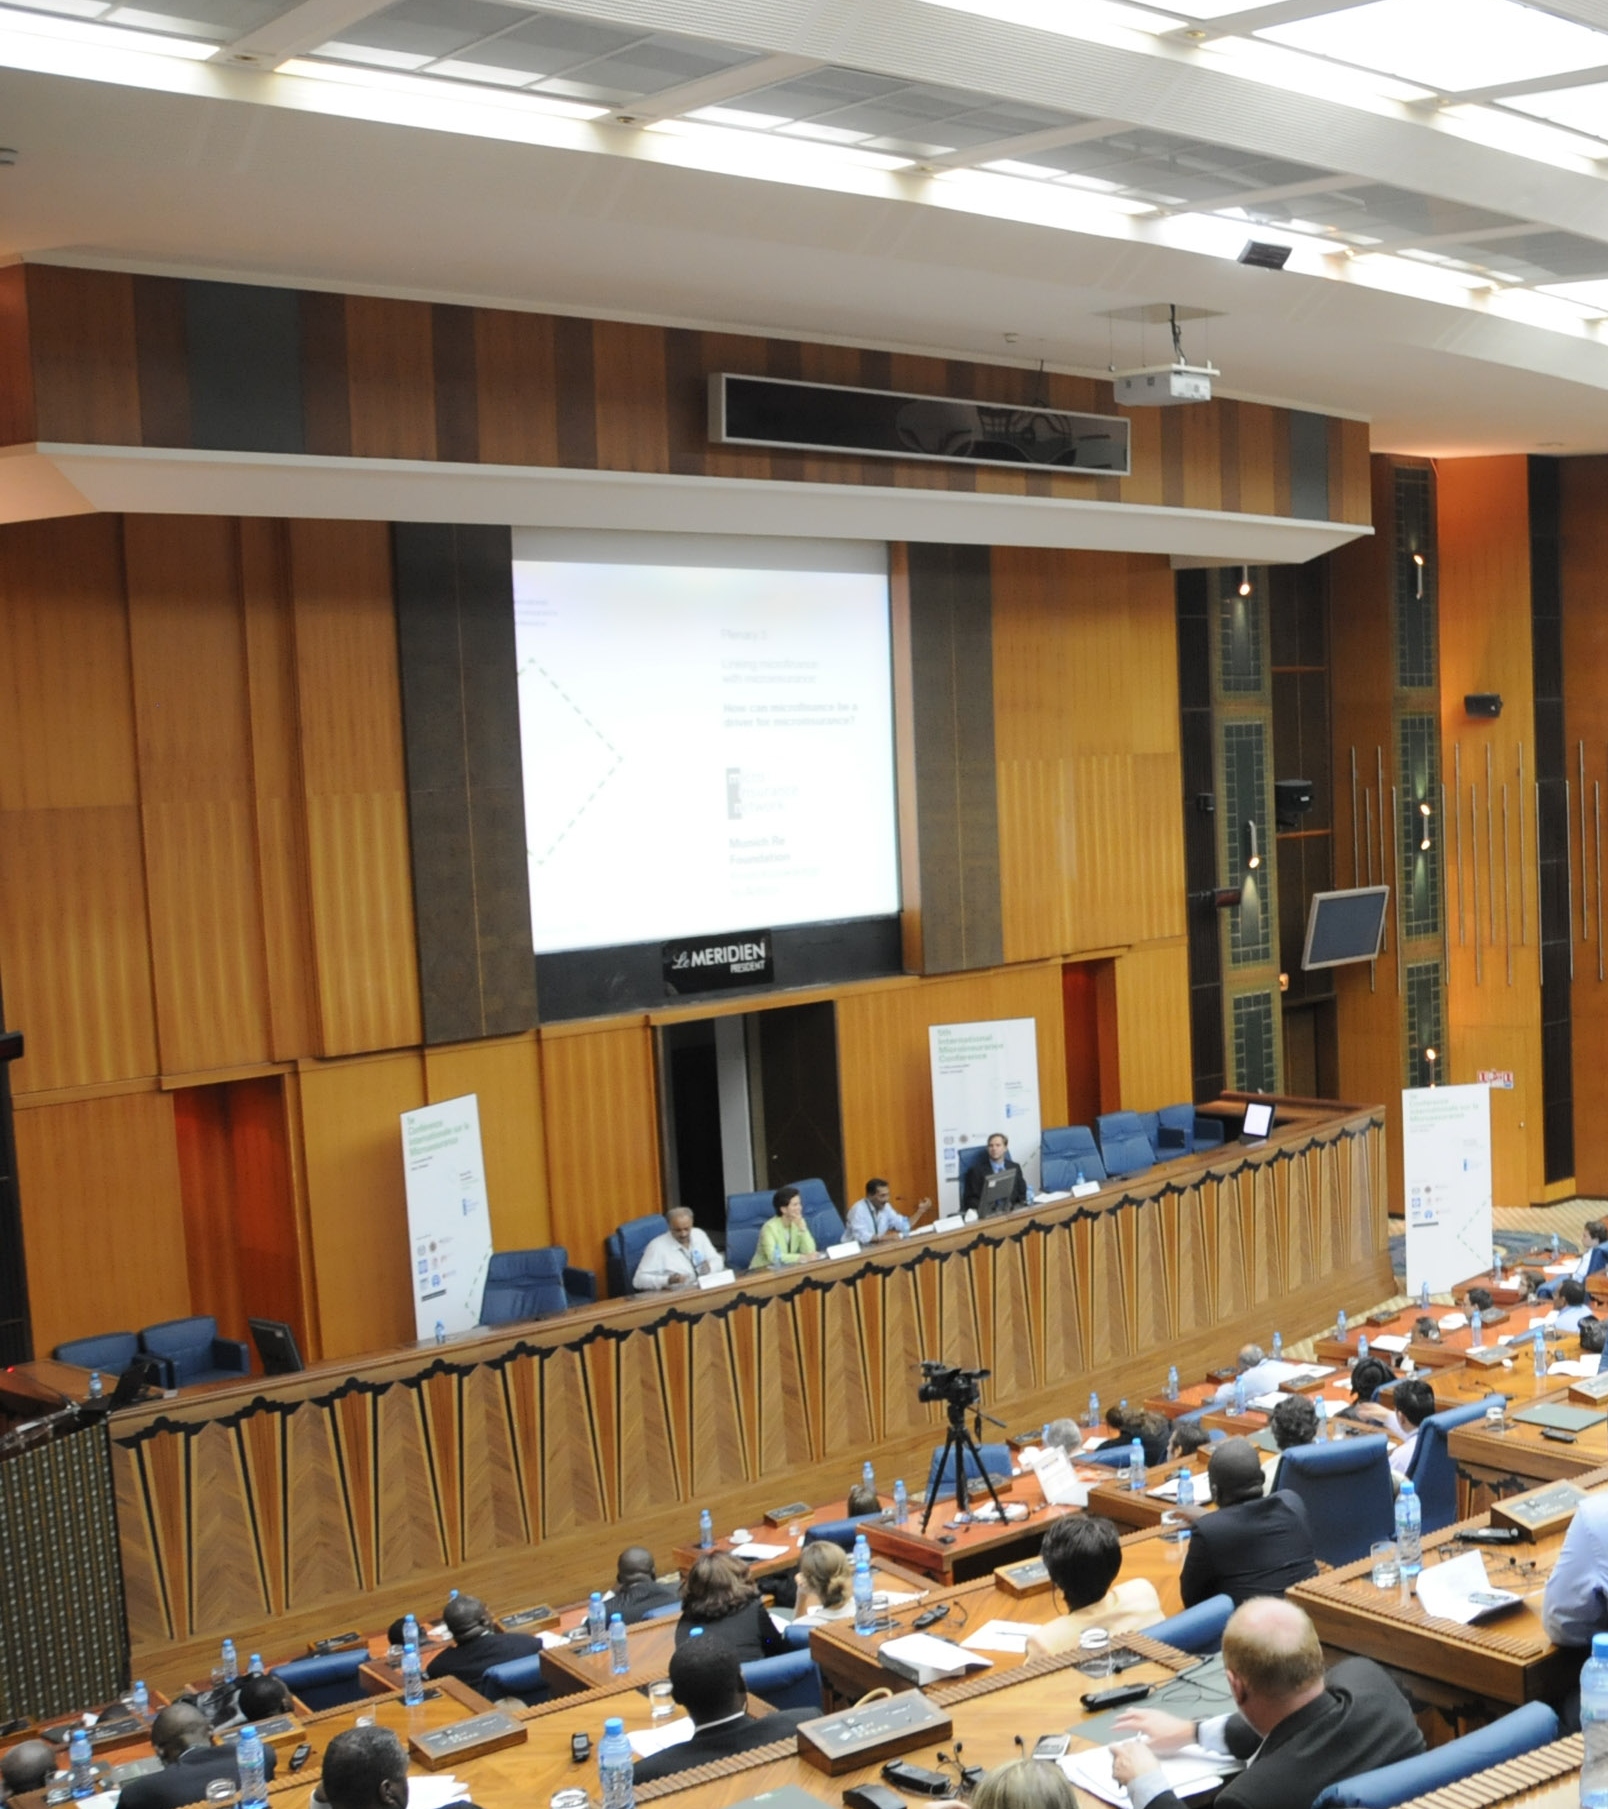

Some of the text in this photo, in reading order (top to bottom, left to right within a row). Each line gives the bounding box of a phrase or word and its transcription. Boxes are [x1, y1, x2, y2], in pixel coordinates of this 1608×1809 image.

[723, 703, 747, 712] How
[750, 704, 768, 712] can
[770, 701, 835, 712] microfinance
[837, 701, 850, 711] be
[724, 717, 754, 727] driver
[756, 717, 770, 726] for
[729, 851, 791, 865] Foundation
